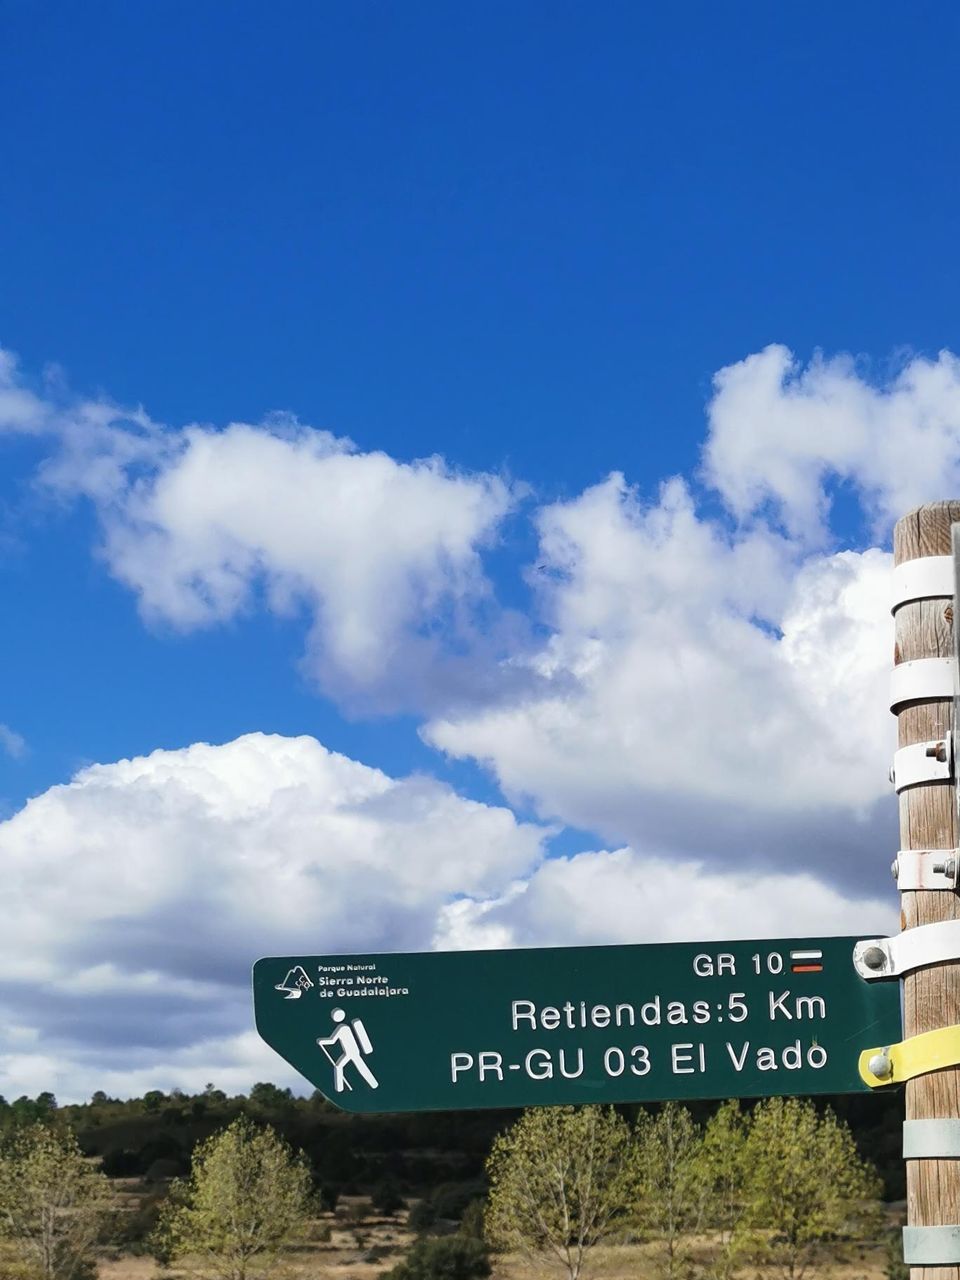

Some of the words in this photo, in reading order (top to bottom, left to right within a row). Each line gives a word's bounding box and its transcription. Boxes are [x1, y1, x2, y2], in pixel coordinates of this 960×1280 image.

[318, 965, 345, 973] Parque
[347, 963, 376, 972] Natural
[693, 953, 736, 977] GR
[752, 952, 783, 975] 10
[318, 976, 354, 986] Sierra
[356, 975, 388, 985] Norte
[320, 989, 334, 998] de
[337, 986, 409, 997] Guadalajara
[769, 990, 827, 1021] Km
[450, 1047, 584, 1083] PR-GU
[603, 1045, 651, 1077] 03
[671, 1042, 706, 1074] El
[726, 1039, 828, 1072] Vado
